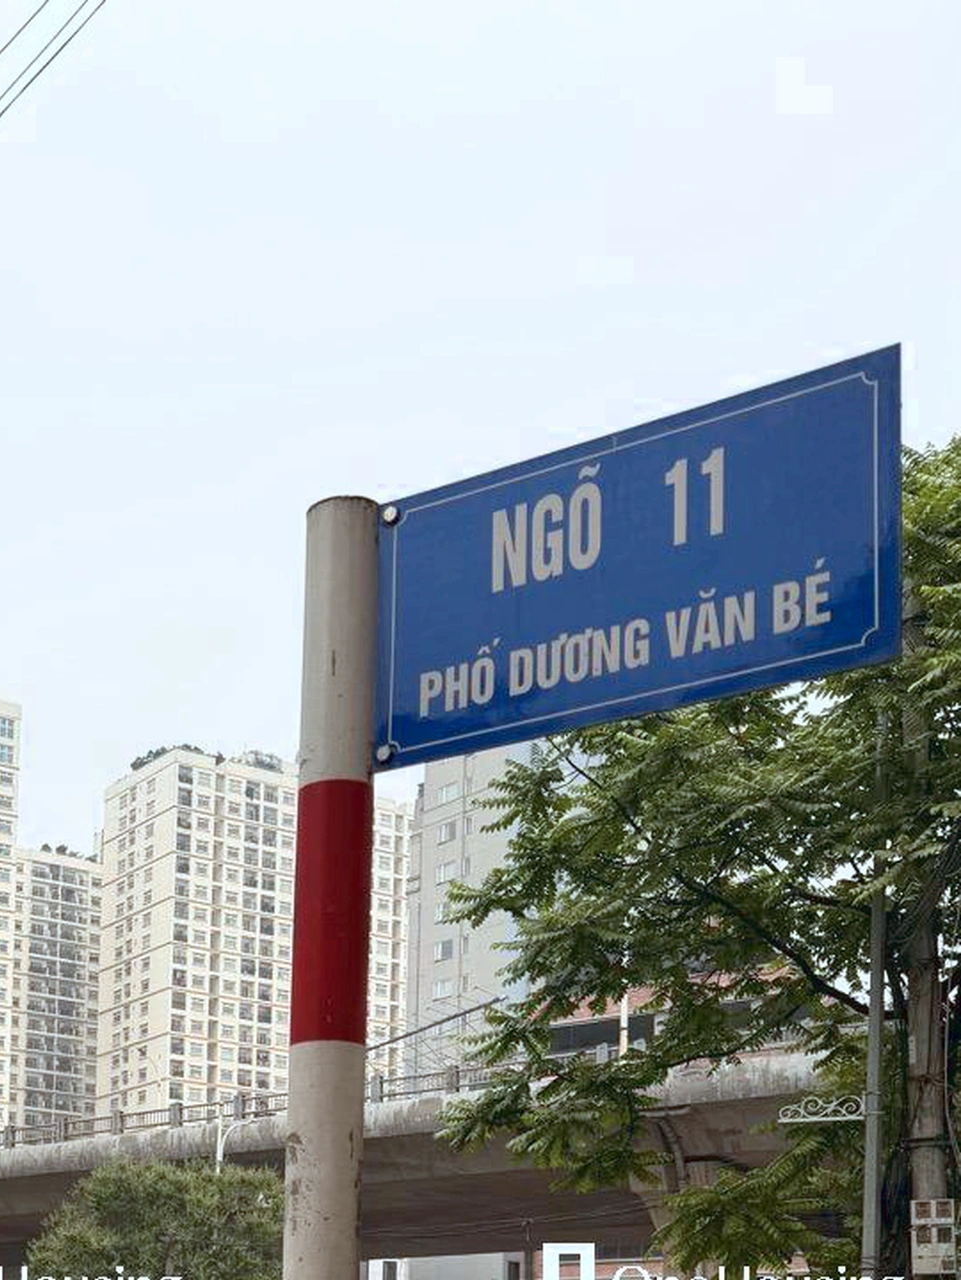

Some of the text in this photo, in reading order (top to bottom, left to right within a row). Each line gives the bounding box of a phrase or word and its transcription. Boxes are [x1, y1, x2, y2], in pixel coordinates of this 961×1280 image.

[492, 447, 726, 594] NGÕ 11
[419, 557, 832, 719] PHỐ DƯƠNG VĂN BÉ
